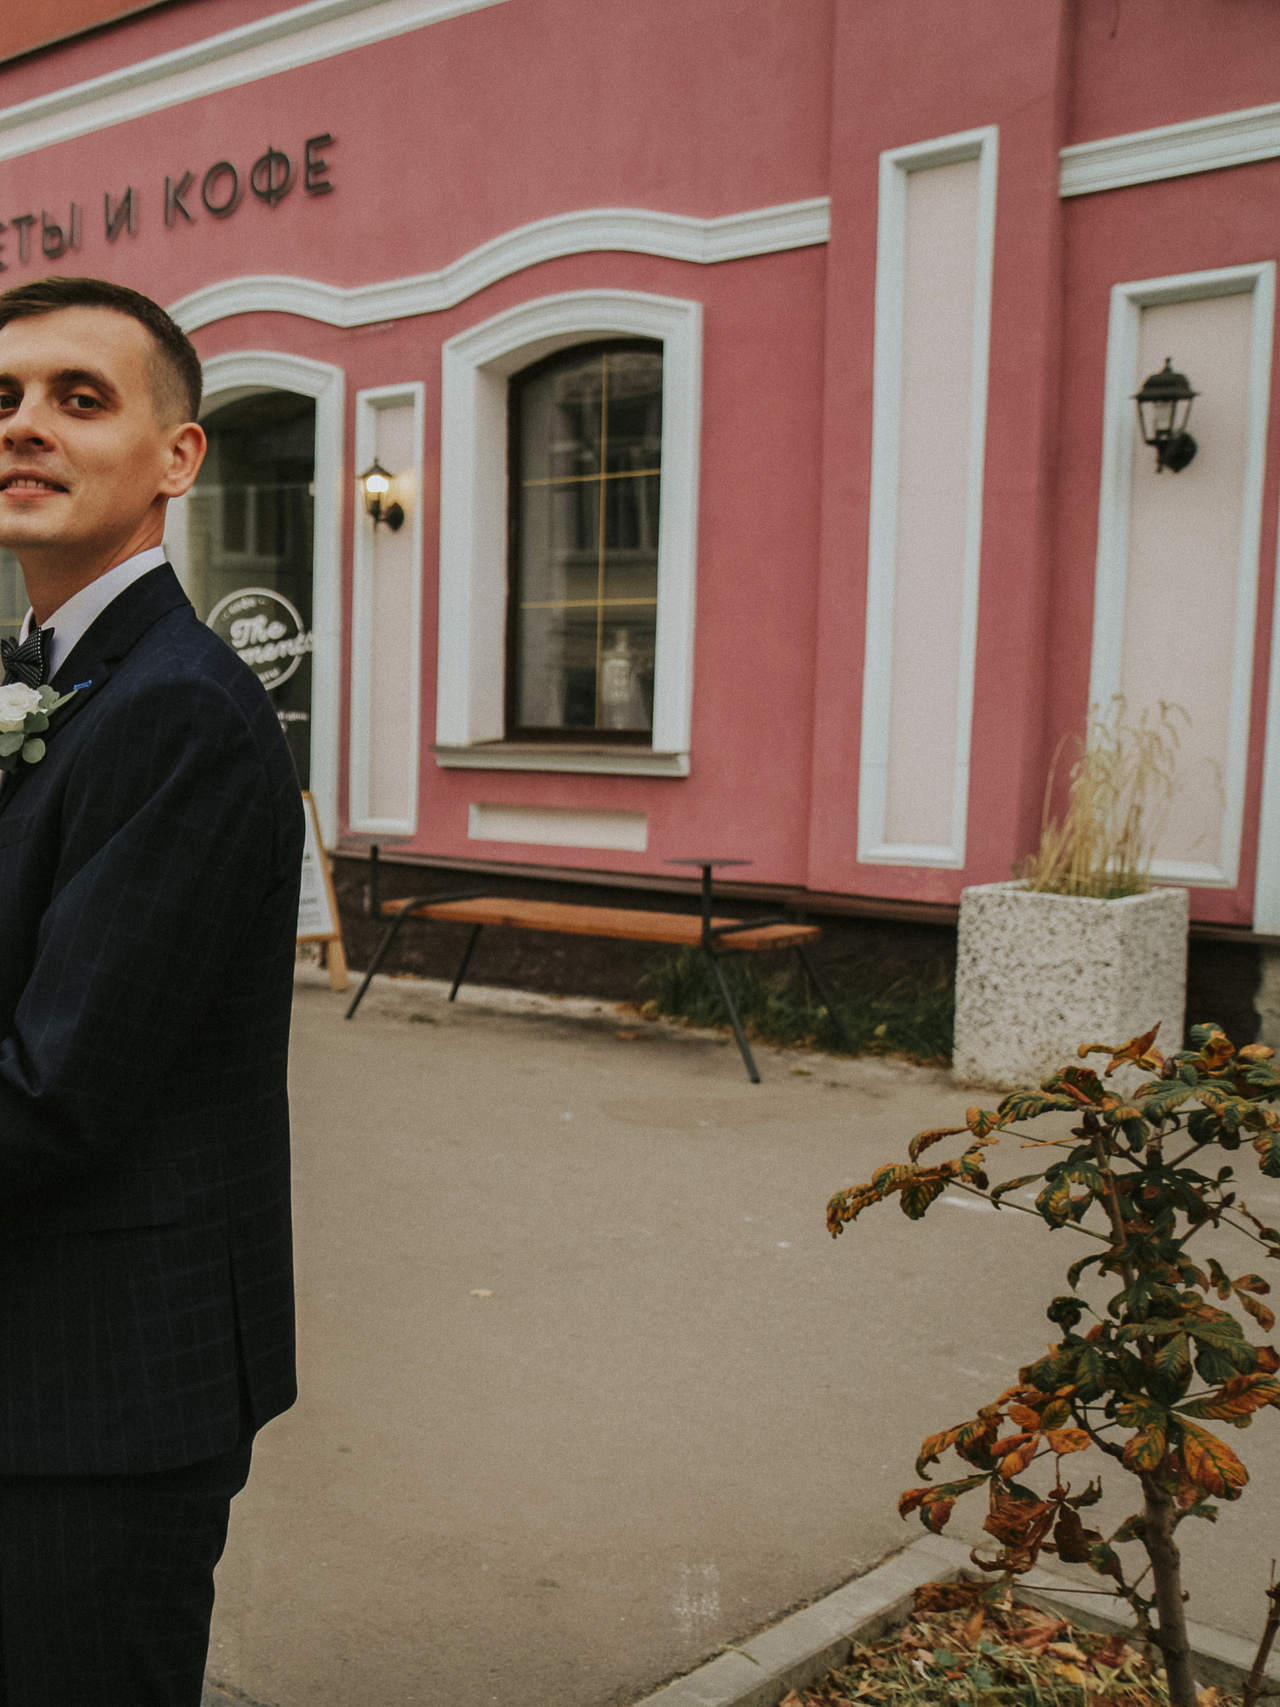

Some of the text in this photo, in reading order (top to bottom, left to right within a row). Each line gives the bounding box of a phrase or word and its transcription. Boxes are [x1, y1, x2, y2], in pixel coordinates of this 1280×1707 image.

[105, 186, 138, 241] И
[164, 134, 336, 229] КОФЕ
[229, 614, 287, 648] The
